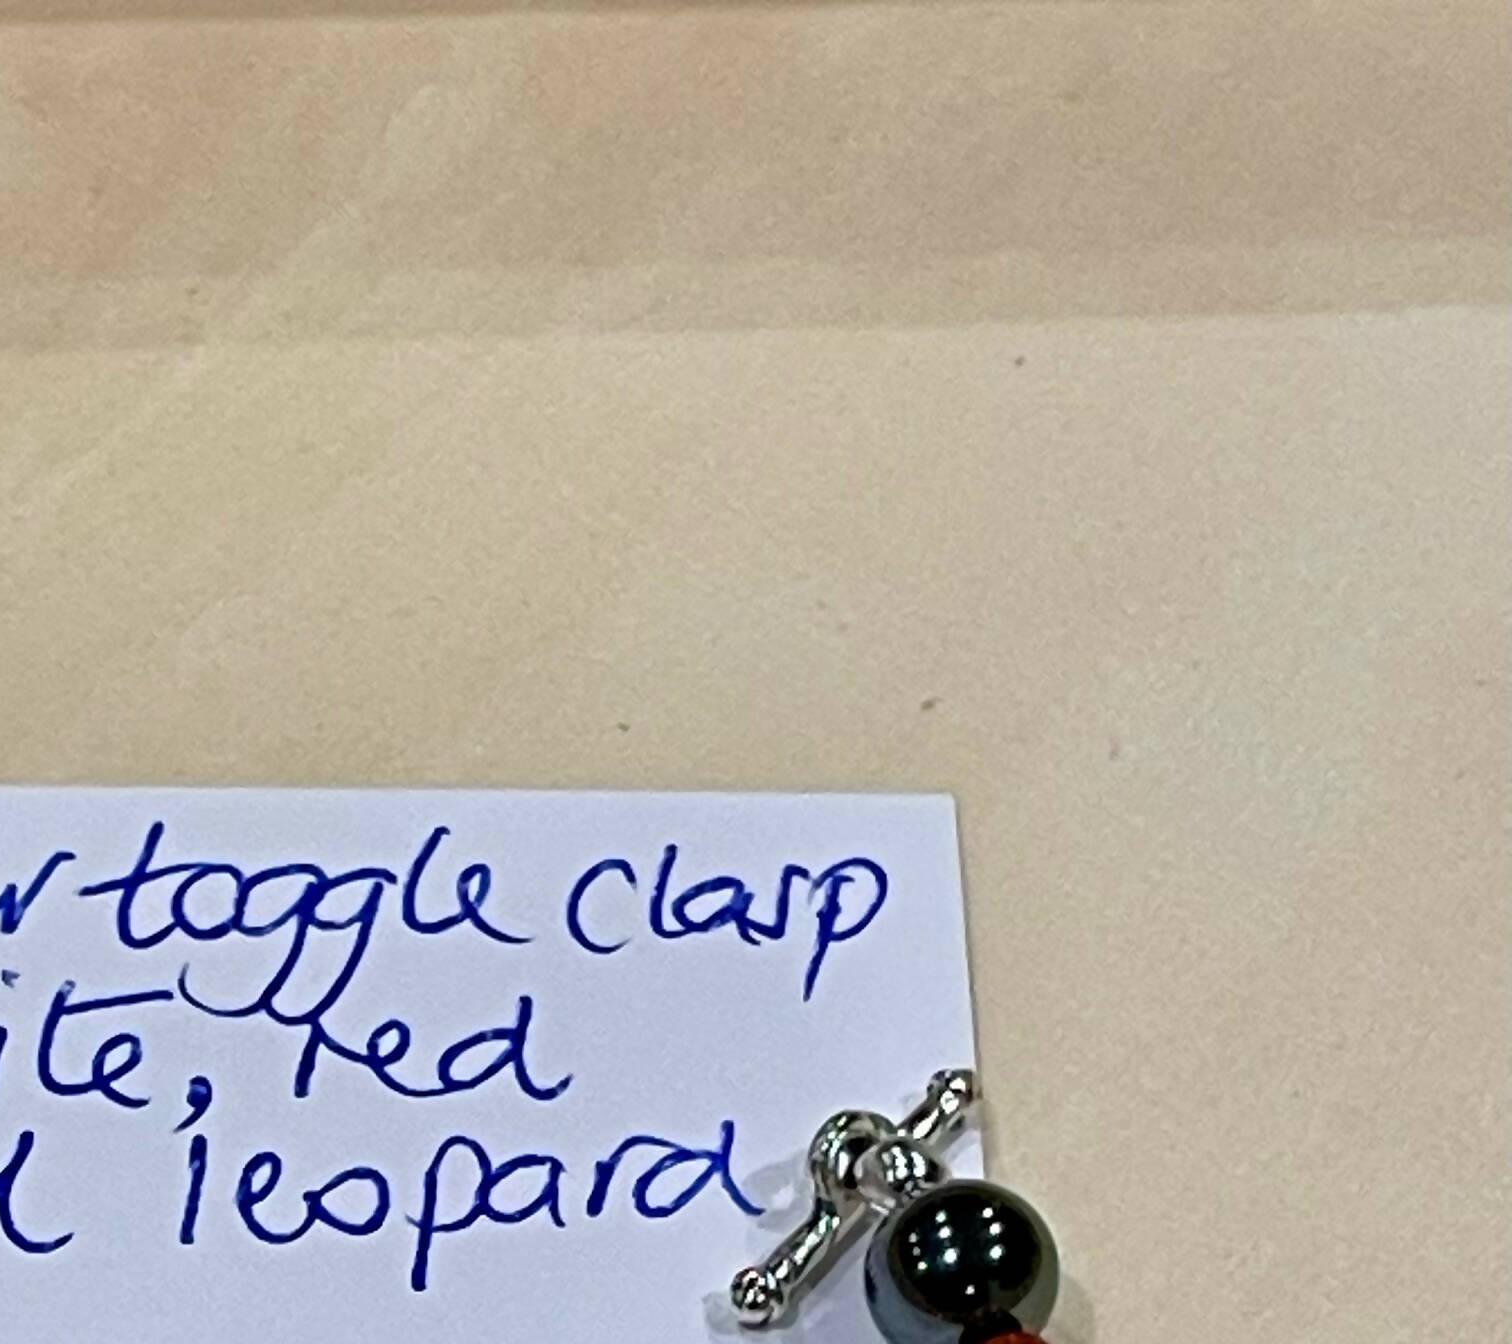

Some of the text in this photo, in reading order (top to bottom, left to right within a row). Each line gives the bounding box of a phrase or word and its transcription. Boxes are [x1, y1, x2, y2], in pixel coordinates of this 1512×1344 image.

[80, 820, 534, 1017] toggle
[565, 843, 889, 1000] clasp
[292, 995, 574, 1101] red
[178, 1119, 767, 1293] leopard
